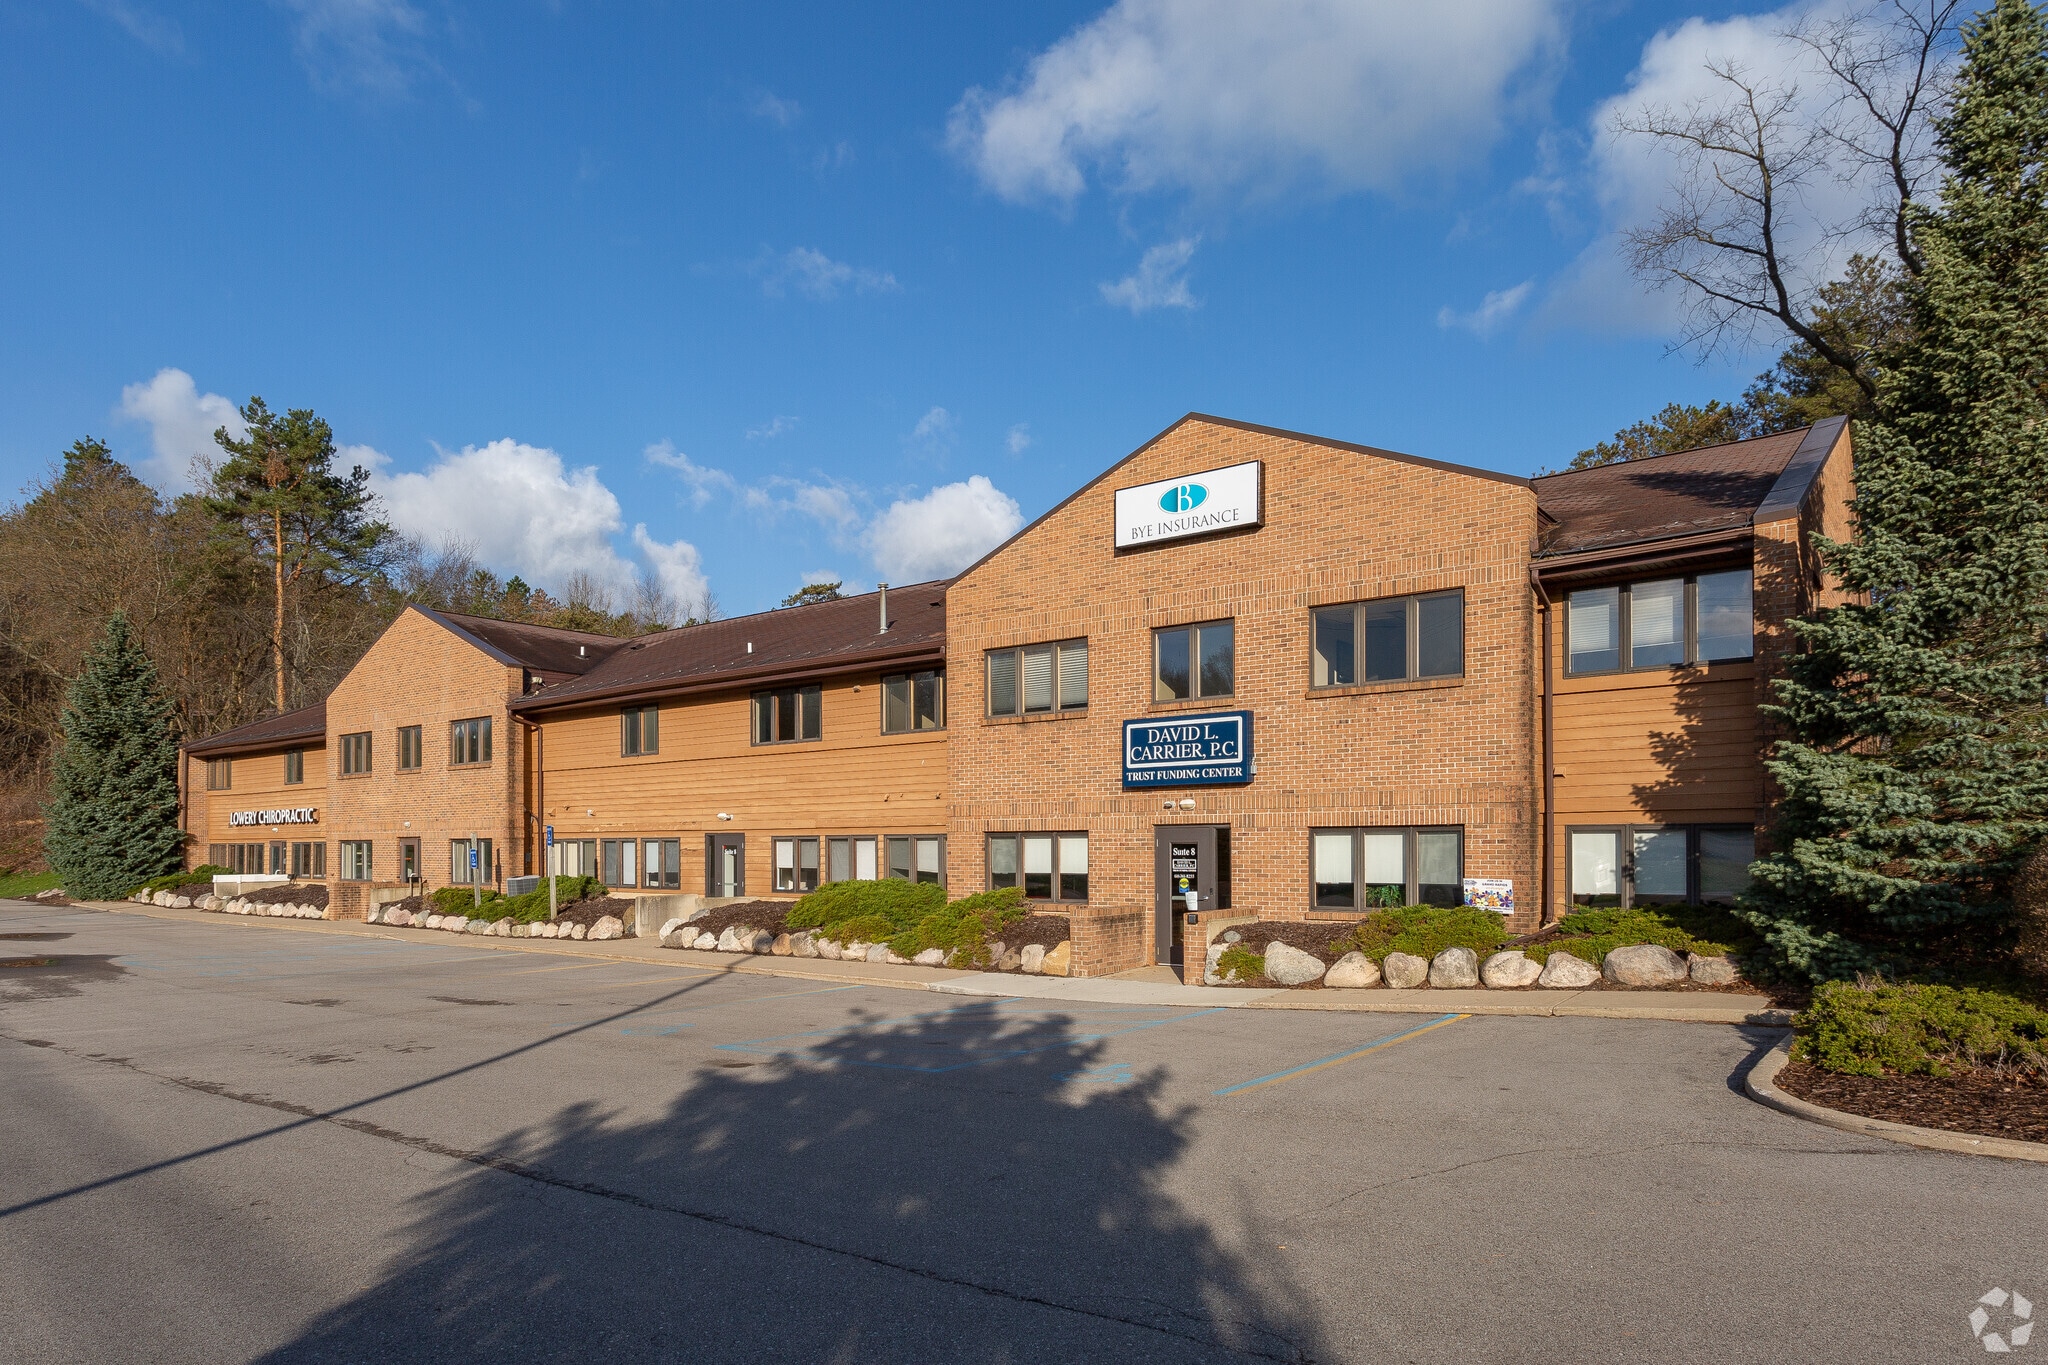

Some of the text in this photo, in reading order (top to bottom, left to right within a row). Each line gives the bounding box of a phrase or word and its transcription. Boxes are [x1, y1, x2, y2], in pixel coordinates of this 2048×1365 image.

[1176, 484, 1193, 513] B
[1131, 508, 1239, 540] BYE INSURANCE
[1147, 725, 1219, 743] DAVID L.
[1131, 741, 1238, 760] CARRIER, P.C.
[1127, 767, 1242, 781] TRUST FUNDING CENTER
[230, 808, 314, 825] LOWERY CHIROPRACTIC
[1173, 847, 1190, 855] Suite
